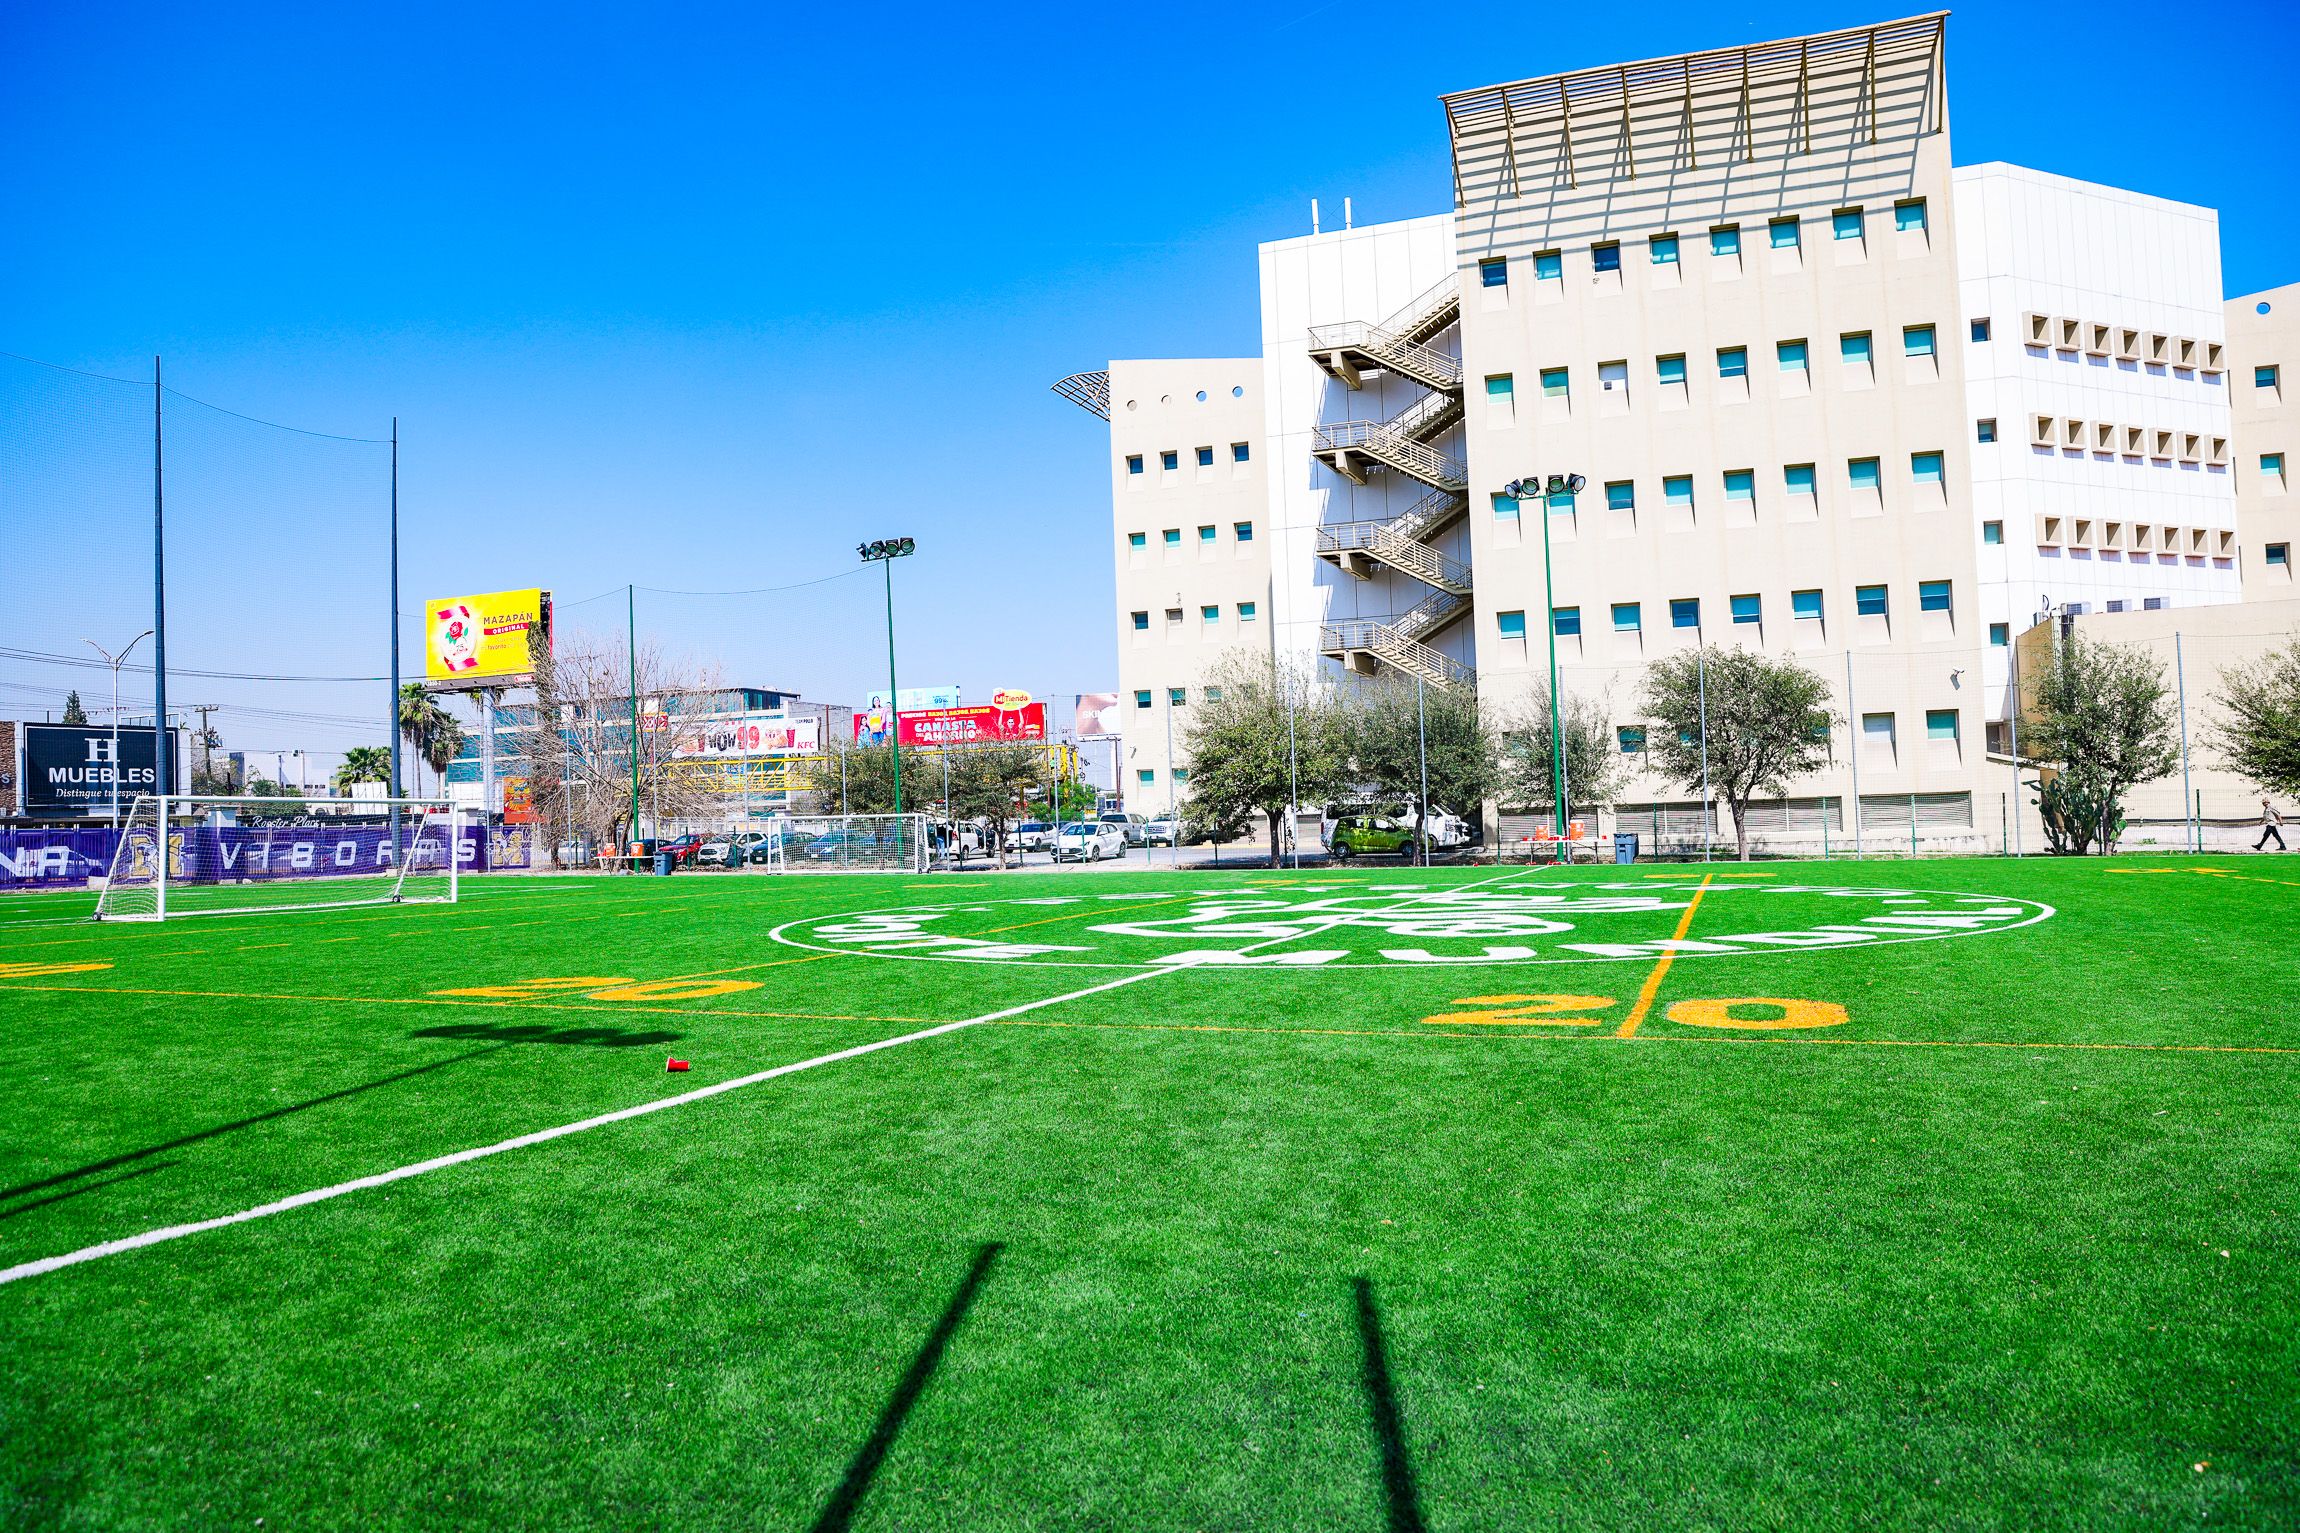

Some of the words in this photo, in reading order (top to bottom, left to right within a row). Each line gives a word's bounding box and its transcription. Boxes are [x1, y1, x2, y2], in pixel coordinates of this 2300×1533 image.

[483, 611, 533, 625] MAZAPÁN
[492, 623, 525, 635] ORIGINAL
[1004, 694, 1028, 702] Tienda
[914, 720, 977, 733] CANASTA
[707, 731, 736, 751] WOW
[737, 725, 760, 750] 99
[797, 741, 815, 749] KFC
[49, 767, 156, 784] MUEBLES
[55, 788, 103, 798] Distingue
[117, 790, 150, 798] espacio
[1144, 907, 2023, 964] MUNDIAL
[425, 975, 766, 1001] 20
[1421, 993, 1850, 1030] 20
